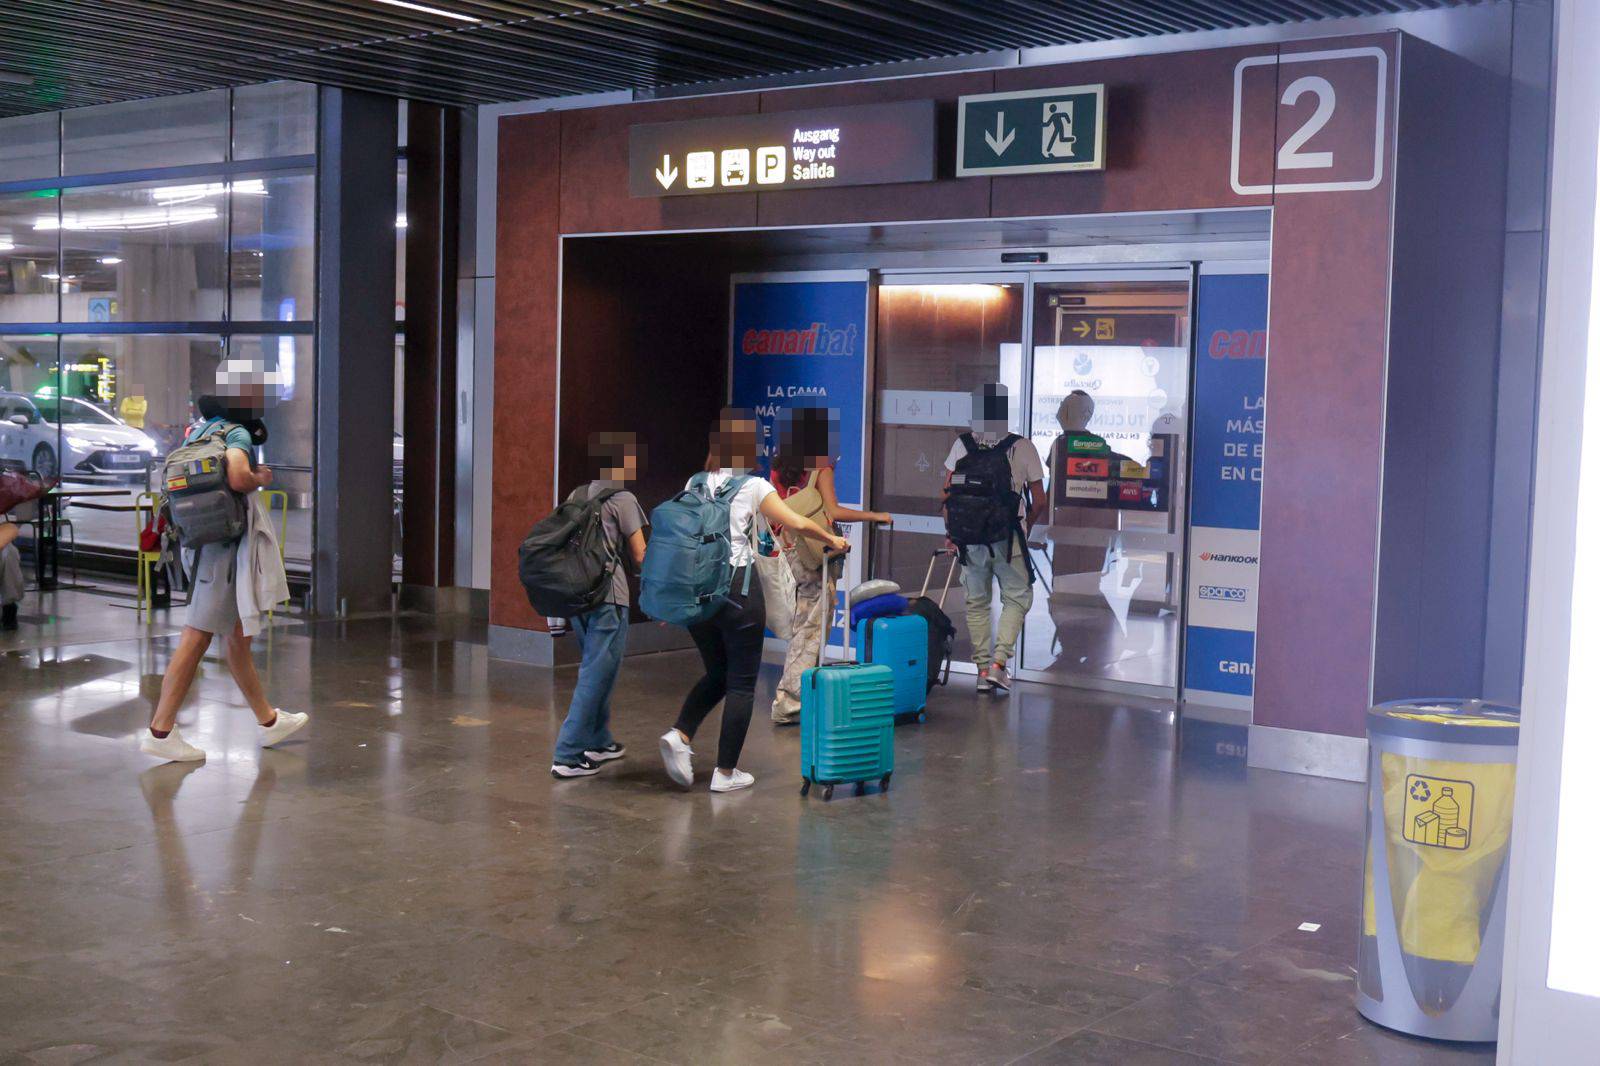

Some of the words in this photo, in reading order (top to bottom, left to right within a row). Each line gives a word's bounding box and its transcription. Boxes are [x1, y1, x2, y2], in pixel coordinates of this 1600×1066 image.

[1277, 75, 1336, 170] 2
[793, 128, 839, 144] Ausgang
[793, 146, 816, 162] Way
[818, 145, 835, 158] out
[766, 154, 778, 178] P
[793, 162, 834, 180] Salida
[742, 322, 856, 355] canaribat
[768, 386, 784, 398] LA
[1244, 397, 1265, 409] LA
[1224, 443, 1248, 457] DE
[1221, 466, 1245, 481] EN
